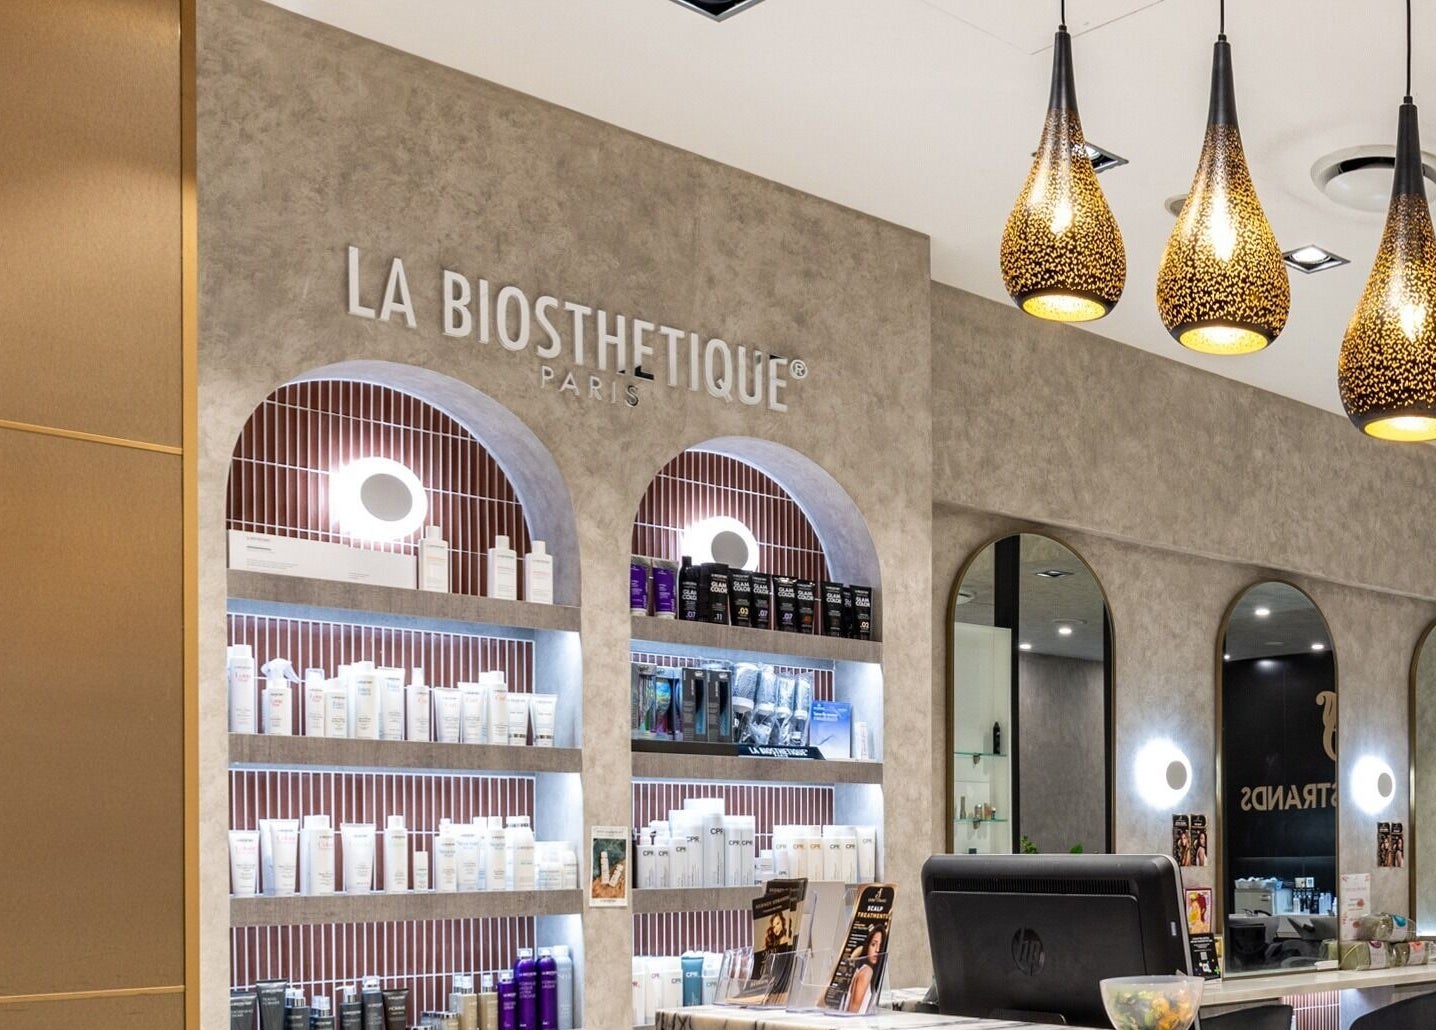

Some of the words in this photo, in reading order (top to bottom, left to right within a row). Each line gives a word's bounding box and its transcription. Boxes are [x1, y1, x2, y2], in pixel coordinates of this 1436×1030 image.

[349, 246, 417, 329] LA
[540, 365, 640, 407] PARIS
[710, 586, 728, 594] COLOR
